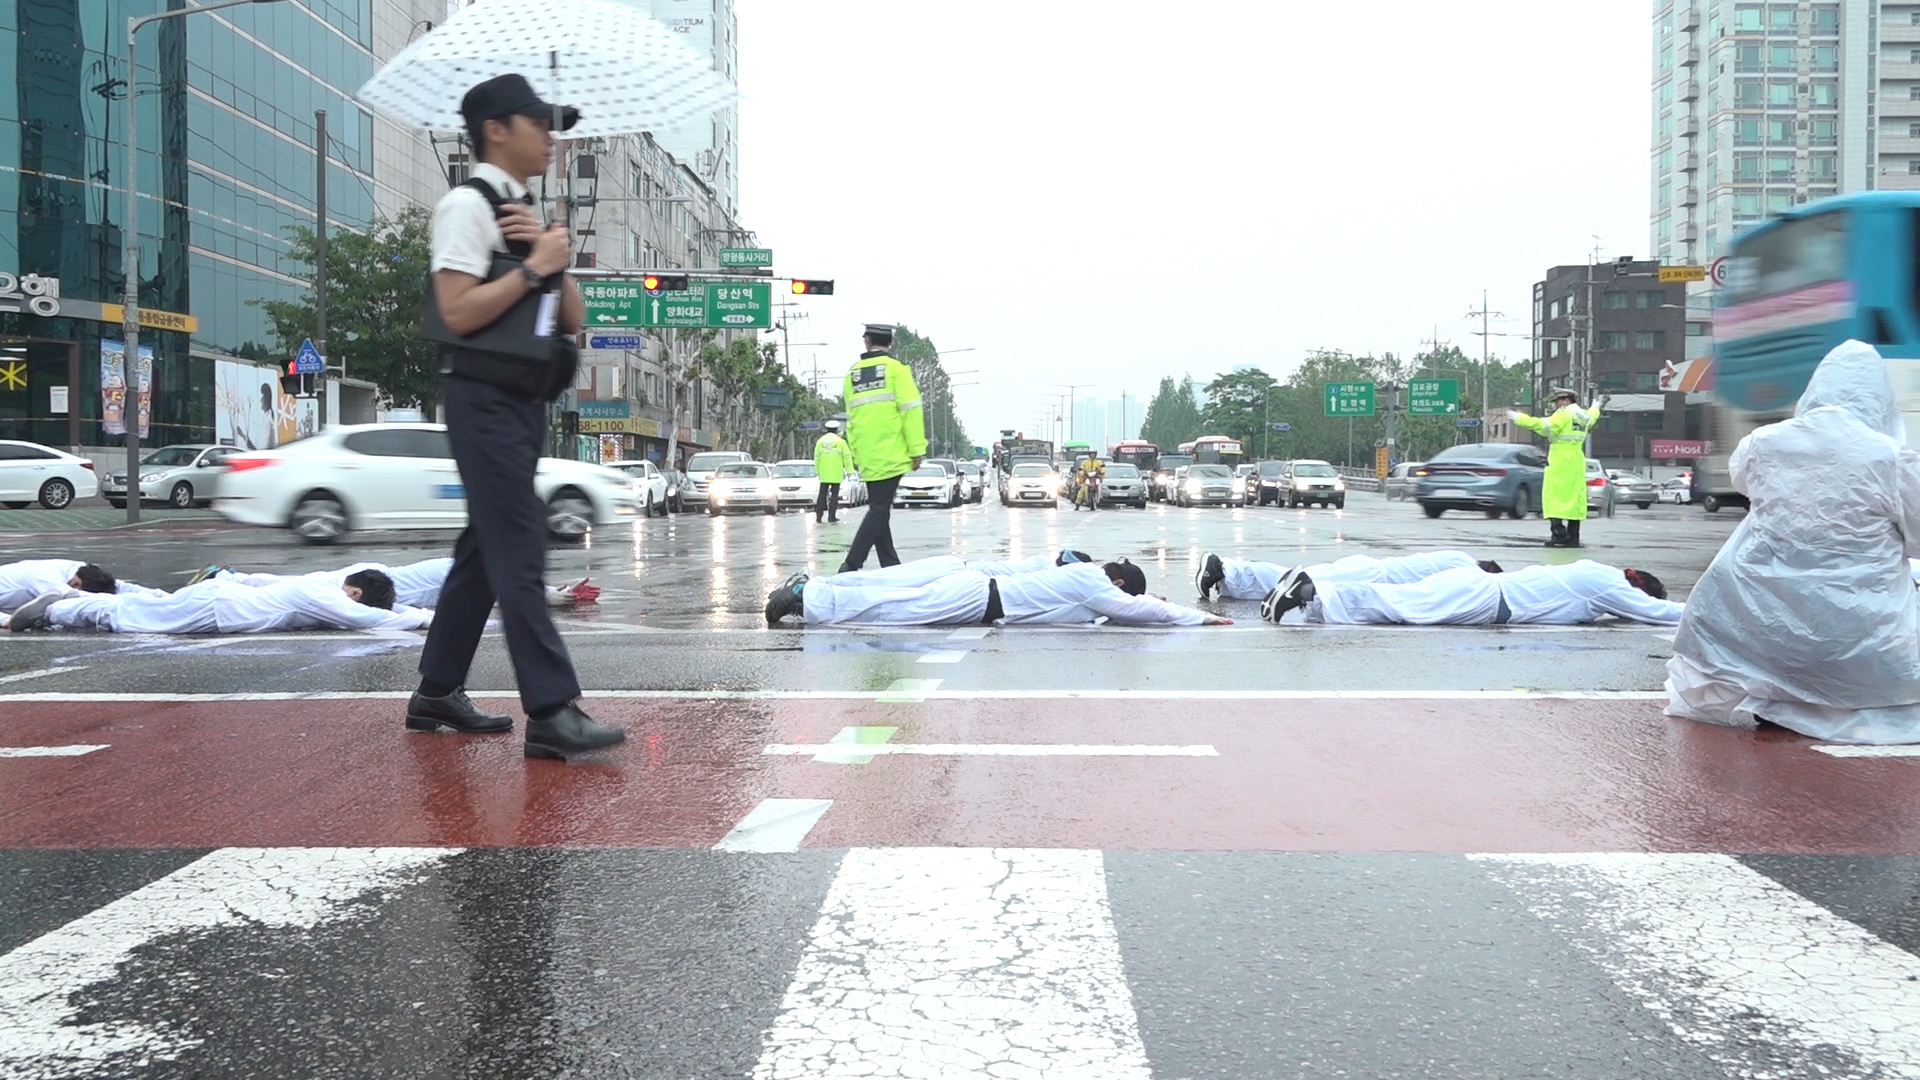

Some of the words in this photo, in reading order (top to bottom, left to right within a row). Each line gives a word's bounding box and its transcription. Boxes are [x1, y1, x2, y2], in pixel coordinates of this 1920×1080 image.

[722, 252, 769, 263] 양평동사거리
[584, 287, 639, 298] 목동아파트
[584, 300, 616, 310] Mokdong
[618, 301, 632, 310] Apt
[717, 301, 746, 311] Dangsan
[748, 301, 760, 310] Stn
[666, 306, 704, 318] 양화대교
